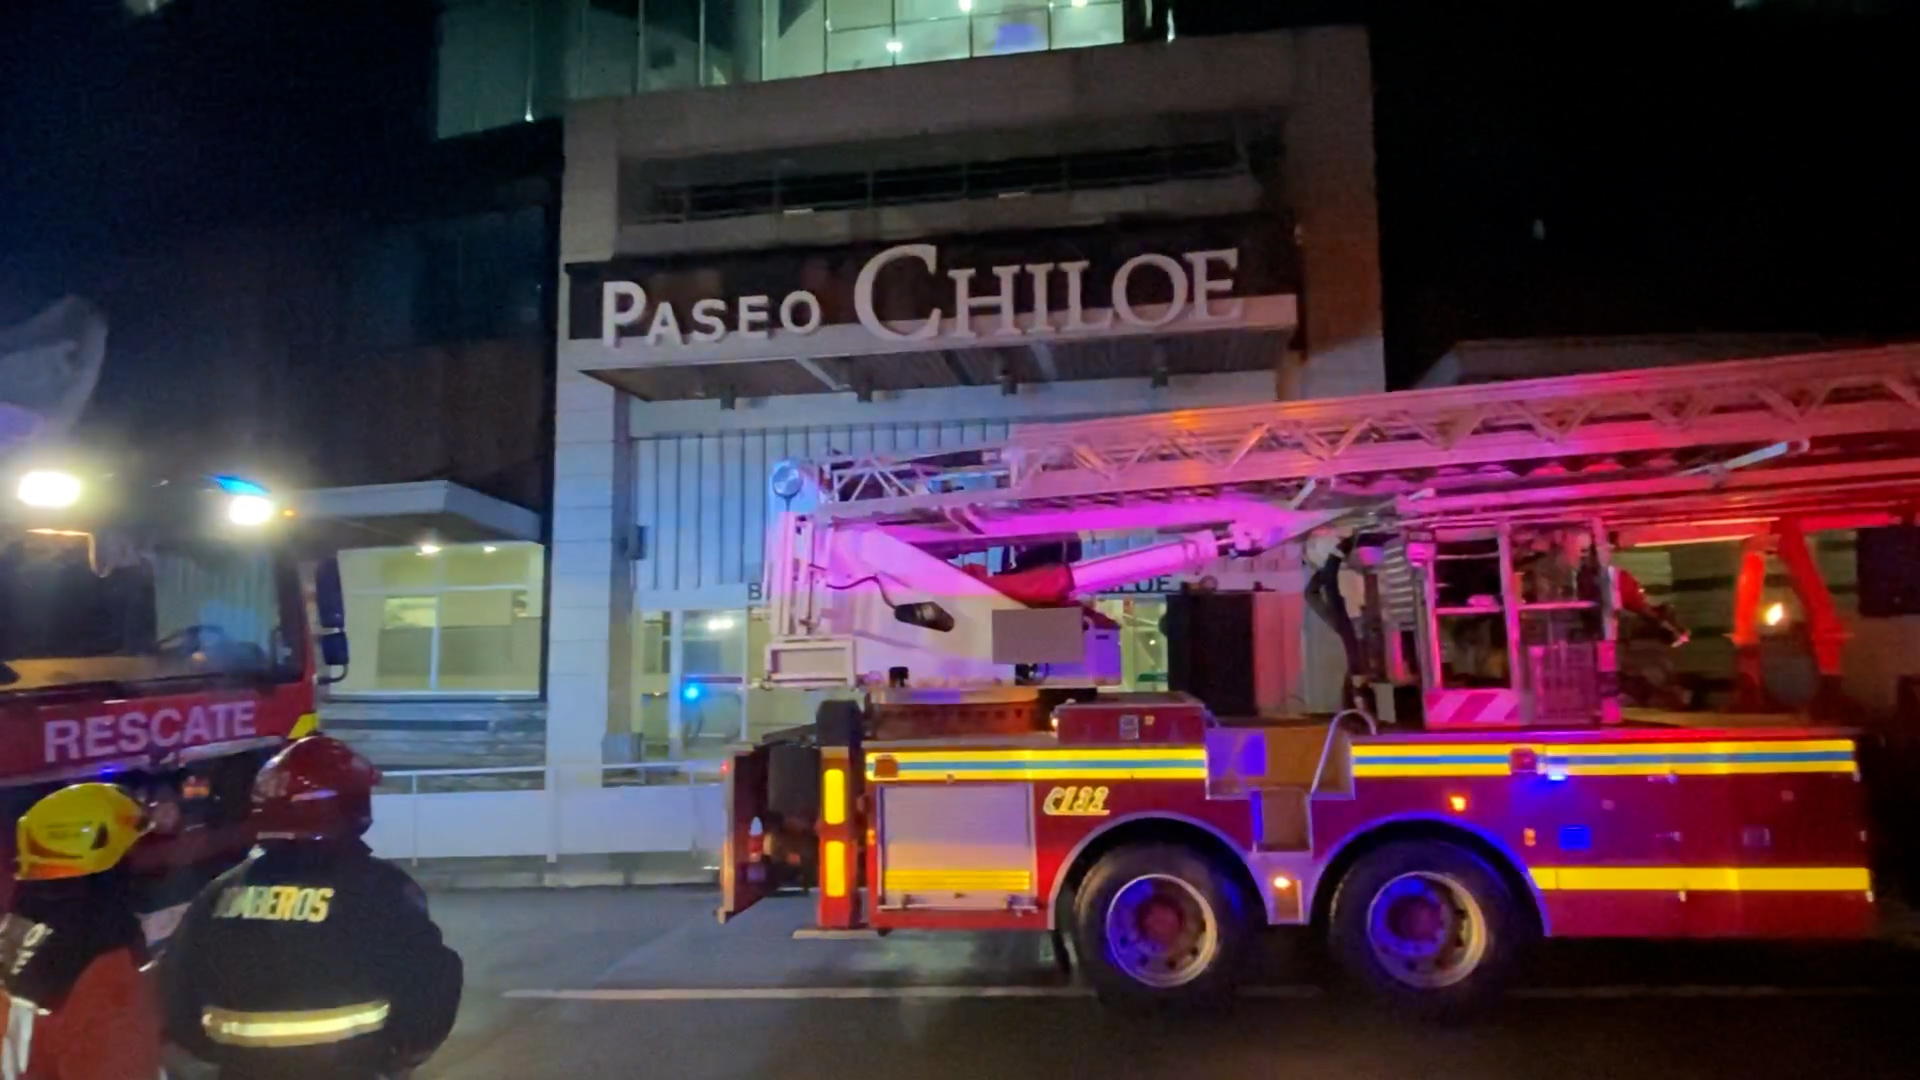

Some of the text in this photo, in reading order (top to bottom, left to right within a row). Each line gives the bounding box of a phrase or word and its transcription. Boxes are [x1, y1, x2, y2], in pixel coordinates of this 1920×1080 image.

[602, 243, 1241, 348] PASEO CHILOE
[44, 701, 256, 763] RESCATE
